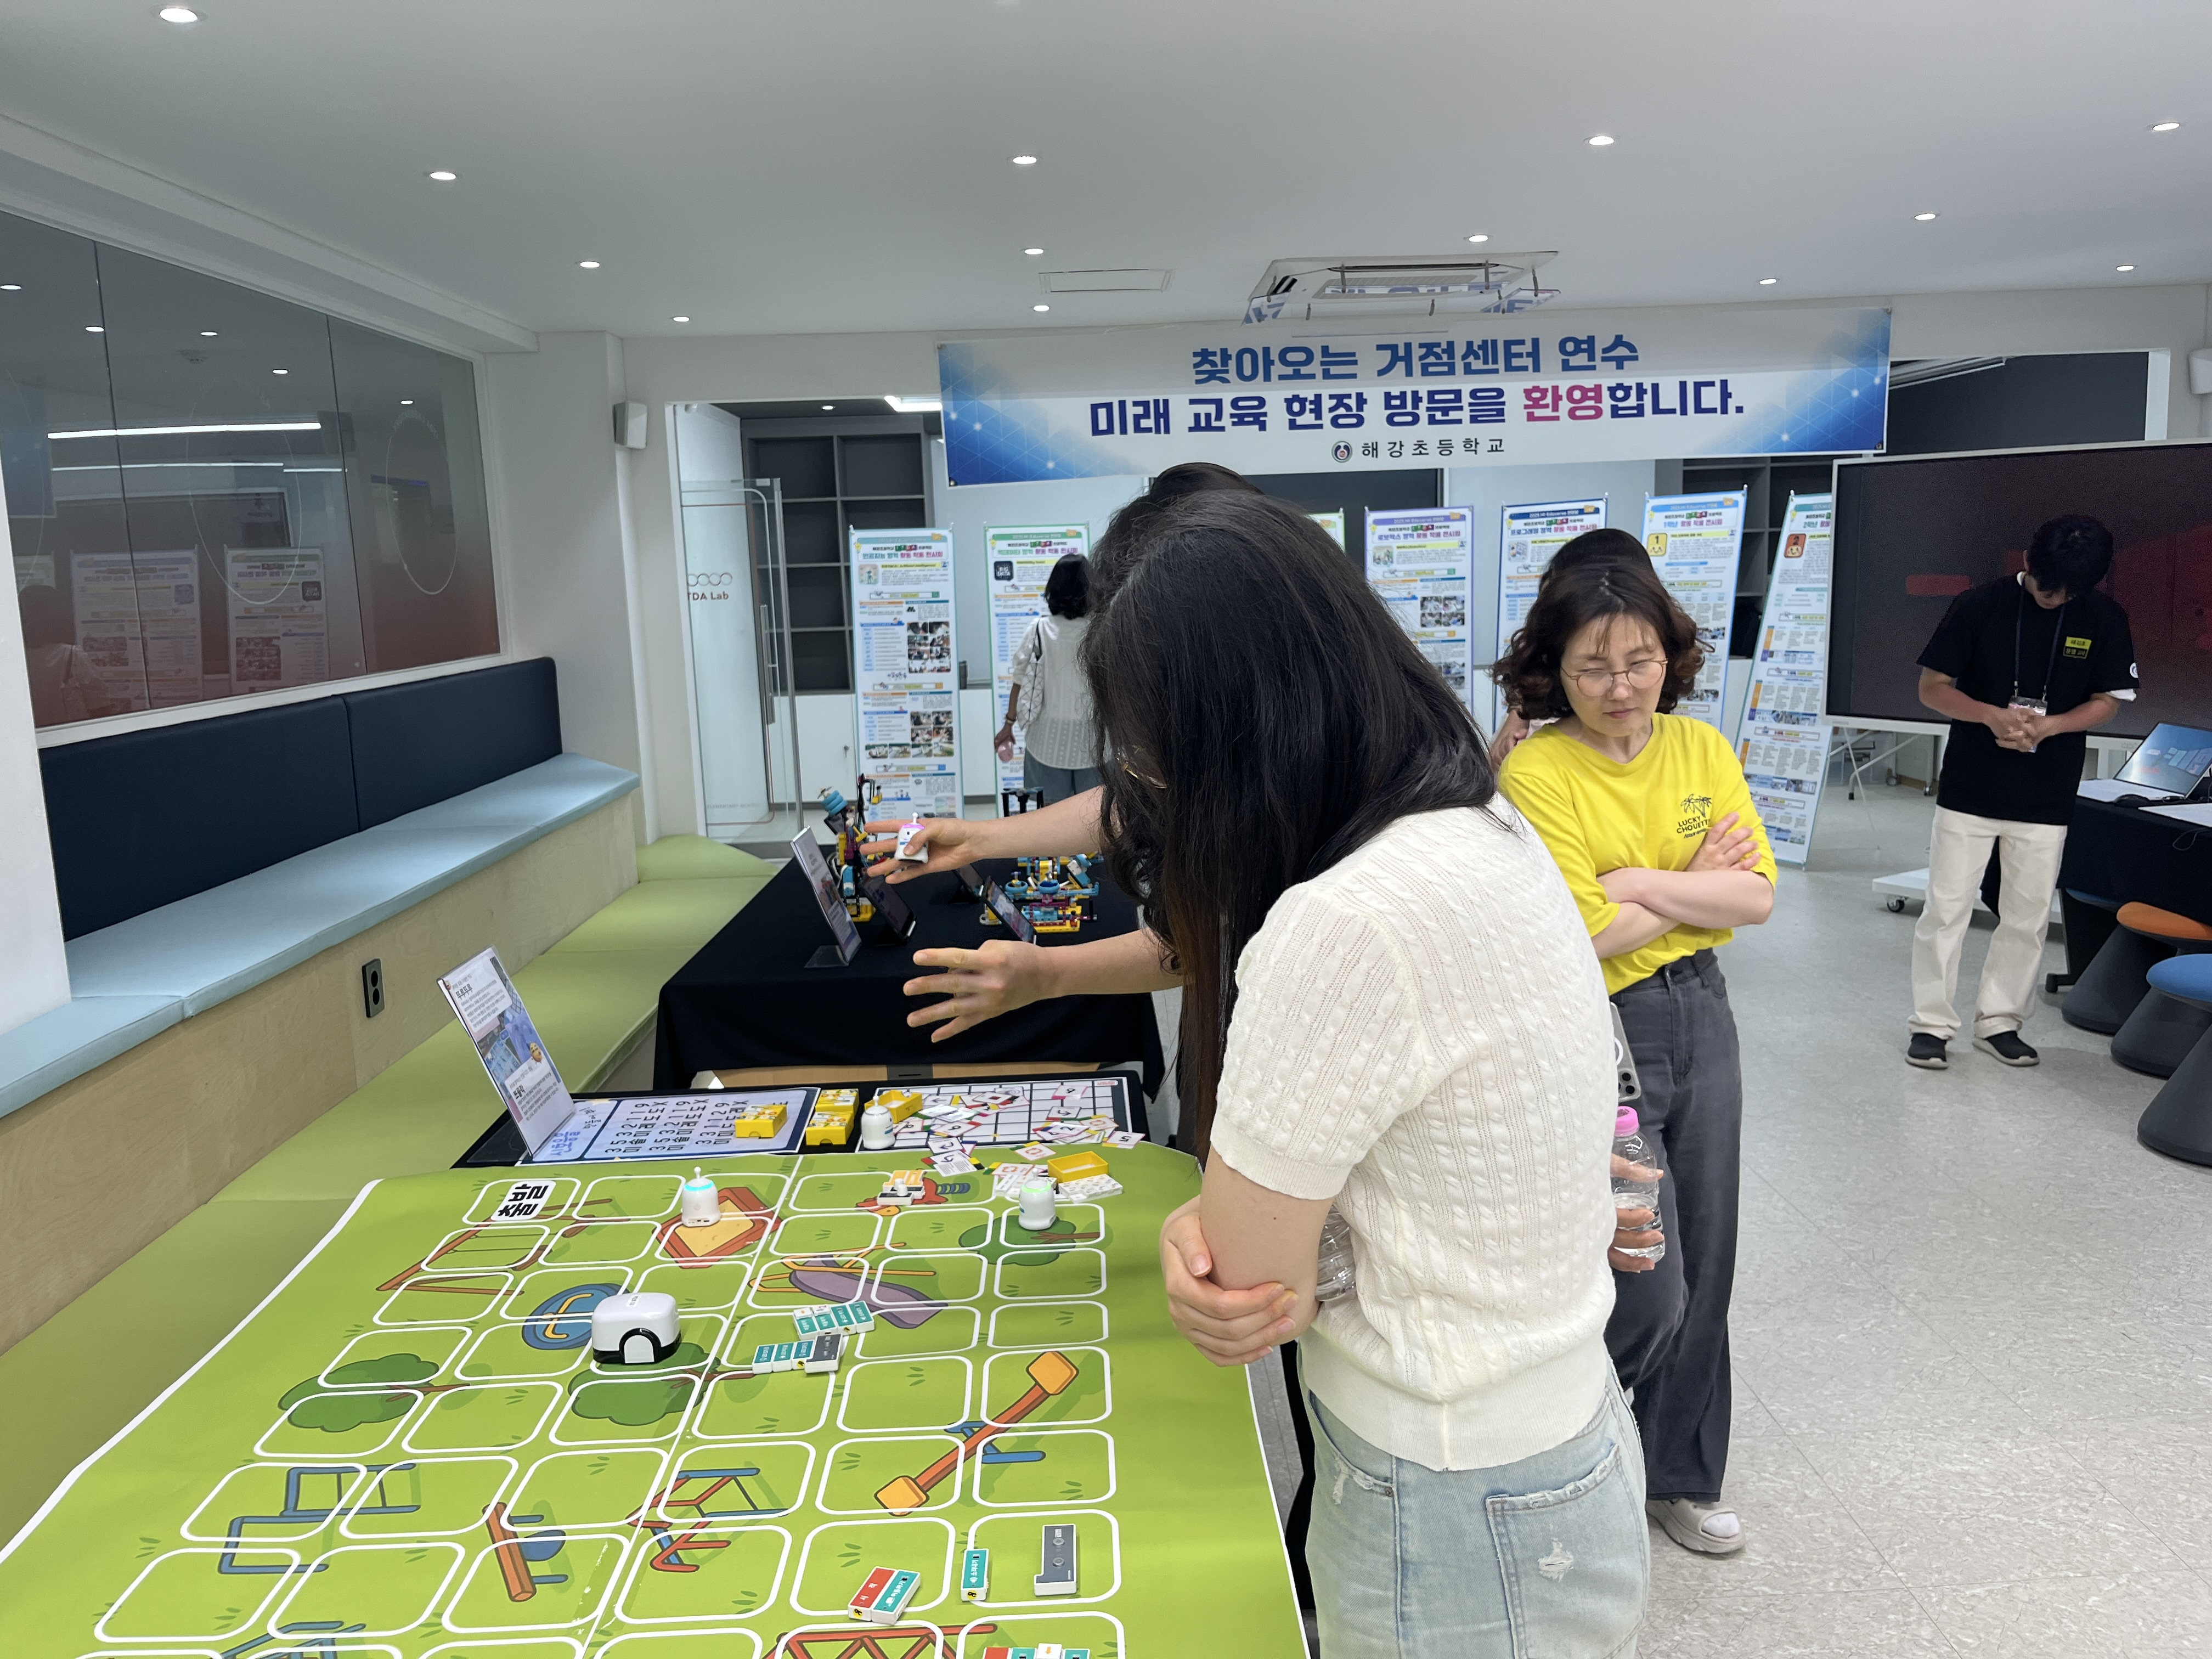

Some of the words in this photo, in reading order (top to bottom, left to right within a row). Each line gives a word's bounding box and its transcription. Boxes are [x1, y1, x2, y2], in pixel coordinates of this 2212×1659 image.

[1192, 343, 1359, 385] 찾아오는
[1376, 336, 1542, 377] 거점센터
[1558, 334, 1639, 371] 연수
[1090, 398, 1170, 437] 미래
[1188, 396, 1268, 433] 교육
[1284, 391, 1368, 430] 현장
[1384, 387, 1506, 427] 방문을
[1523, 379, 1744, 422] 환영합니다.
[1362, 437, 1505, 458] 해강초등학교
[1655, 535, 1659, 544] 1
[1793, 535, 1800, 545] 2
[711, 591, 729, 600] Lab
[1678, 816, 1701, 827] LUCKY
[498, 1183, 549, 1217] 출발
